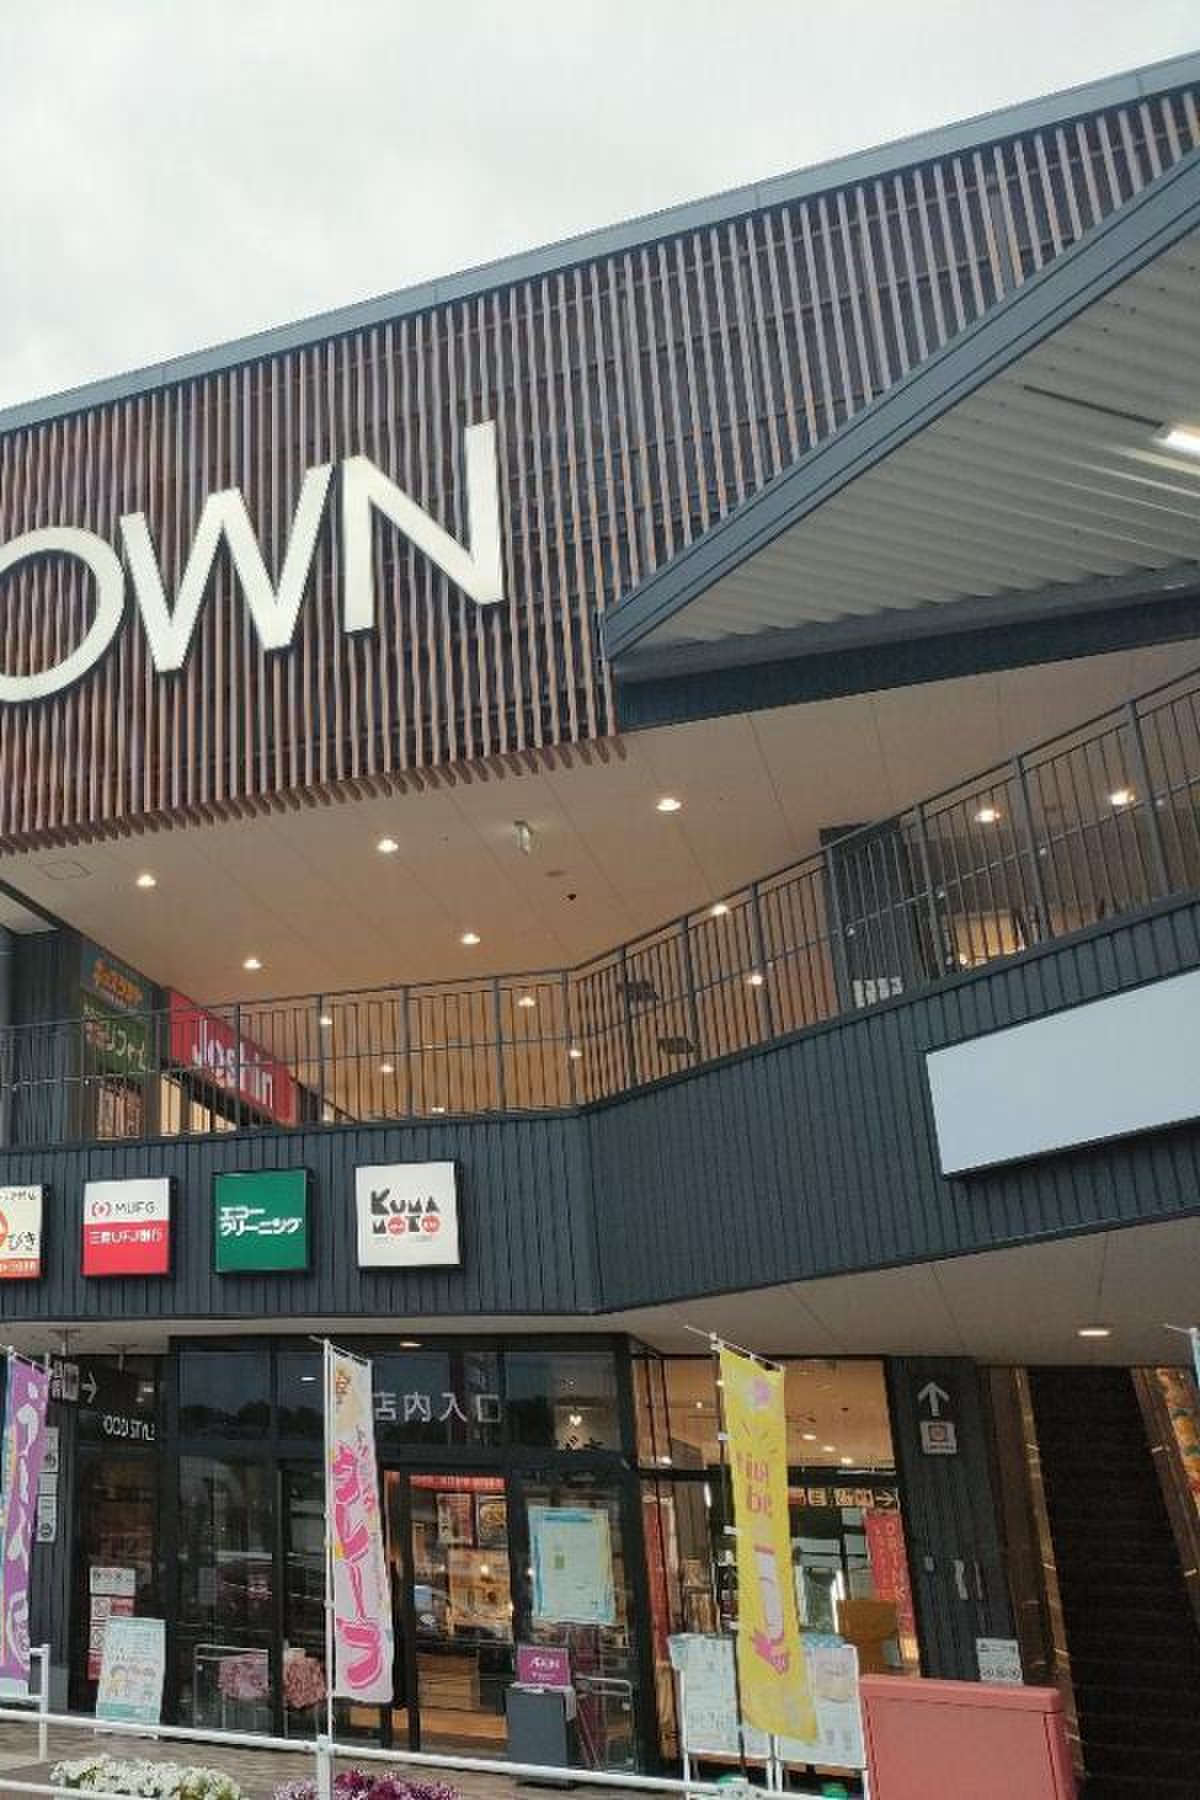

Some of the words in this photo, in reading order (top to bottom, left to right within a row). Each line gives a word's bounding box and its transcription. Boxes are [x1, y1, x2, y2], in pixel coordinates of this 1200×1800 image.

[114, 1200, 156, 1215] MUFG
[220, 1206, 265, 1221] エコー
[220, 1217, 303, 1237] クリーニング
[371, 1391, 501, 1423] 店内入口
